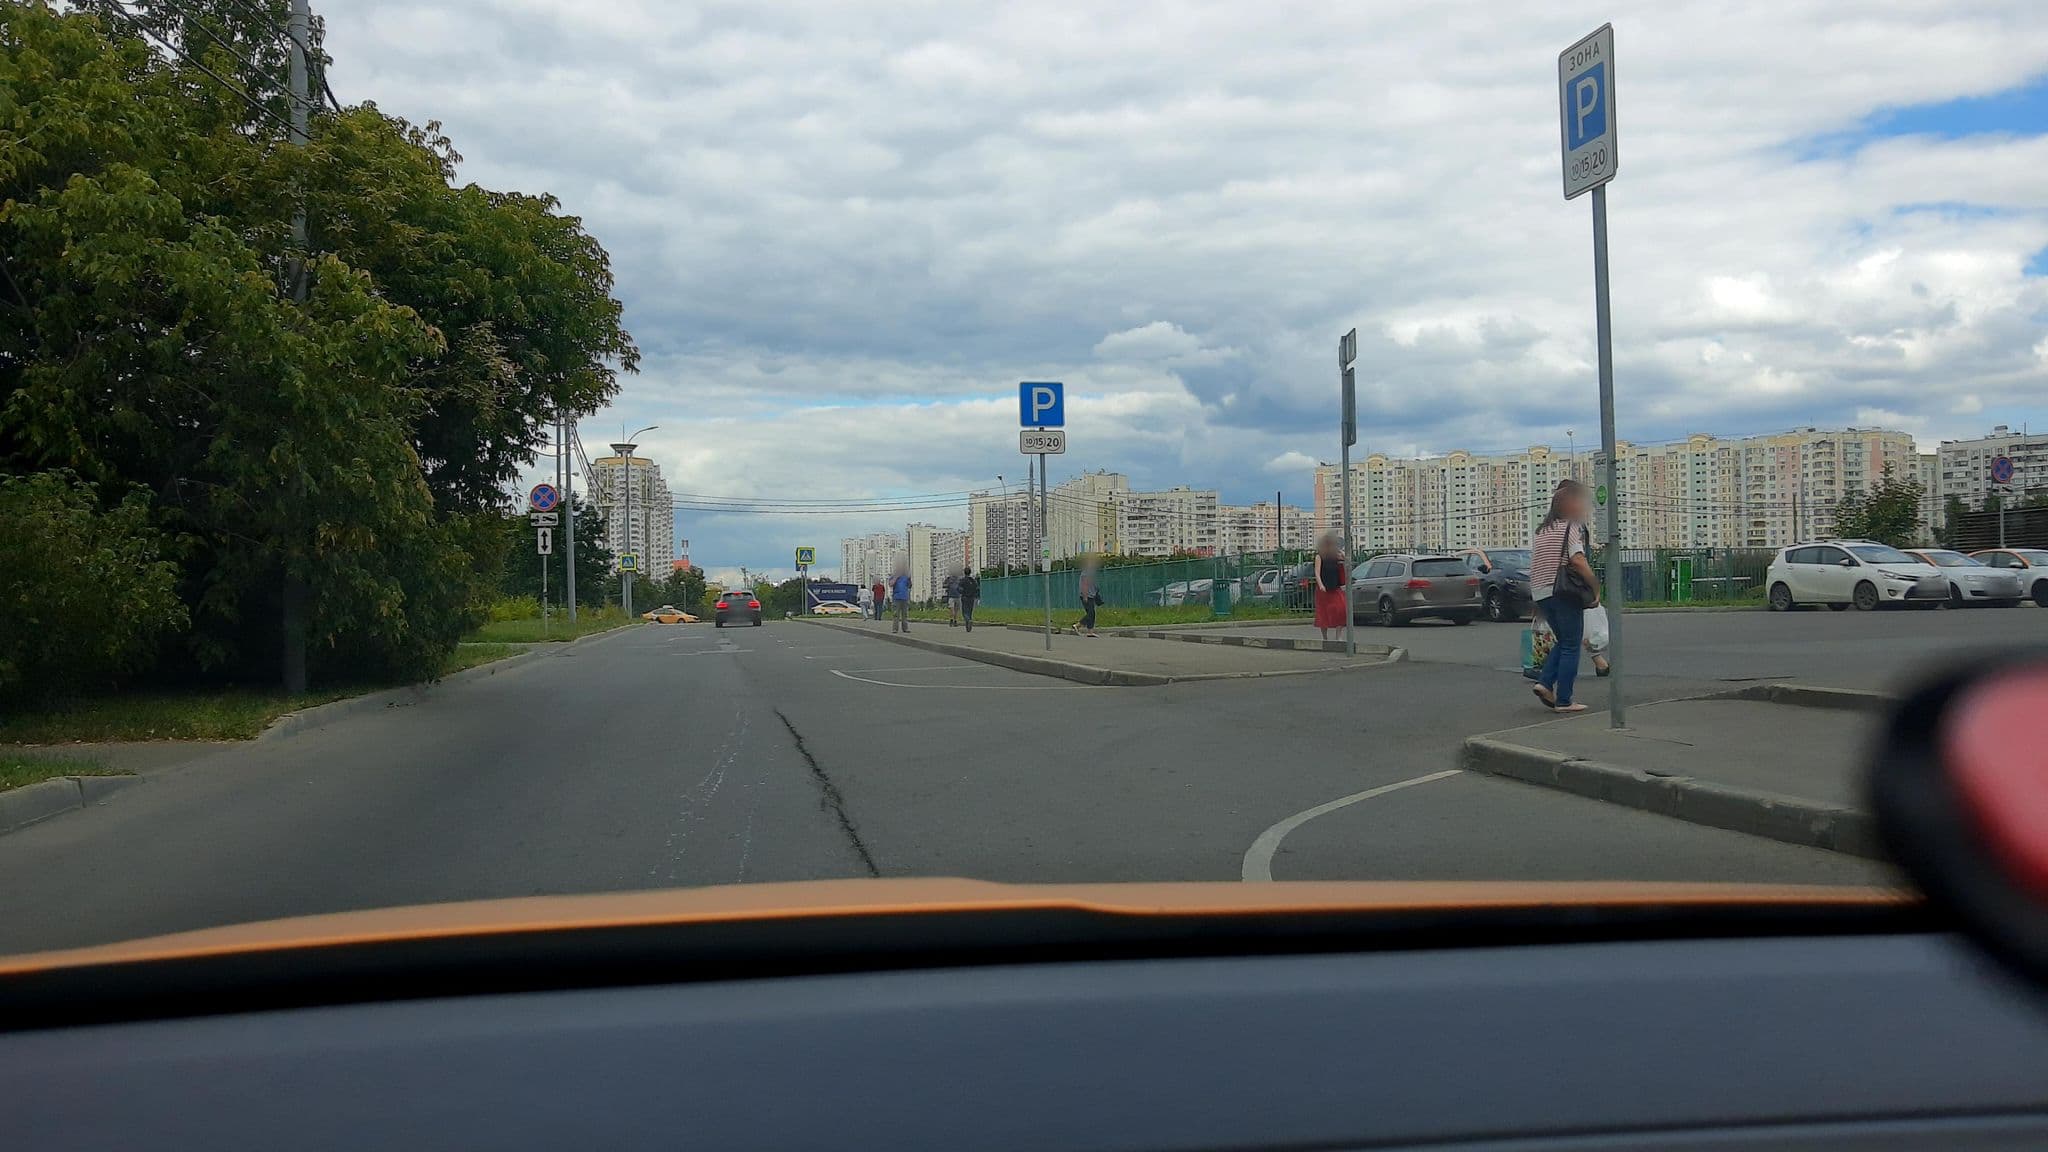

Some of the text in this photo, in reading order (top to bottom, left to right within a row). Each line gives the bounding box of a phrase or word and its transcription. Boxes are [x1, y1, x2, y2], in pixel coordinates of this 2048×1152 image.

[1569, 42, 1600, 72] ЗОНА
[1577, 77, 1598, 139] P
[1580, 157, 1590, 173] 15
[1592, 148, 1605, 170] 20
[1032, 387, 1056, 422] P
[1035, 437, 1043, 446] 15
[1047, 437, 1060, 447] 20
